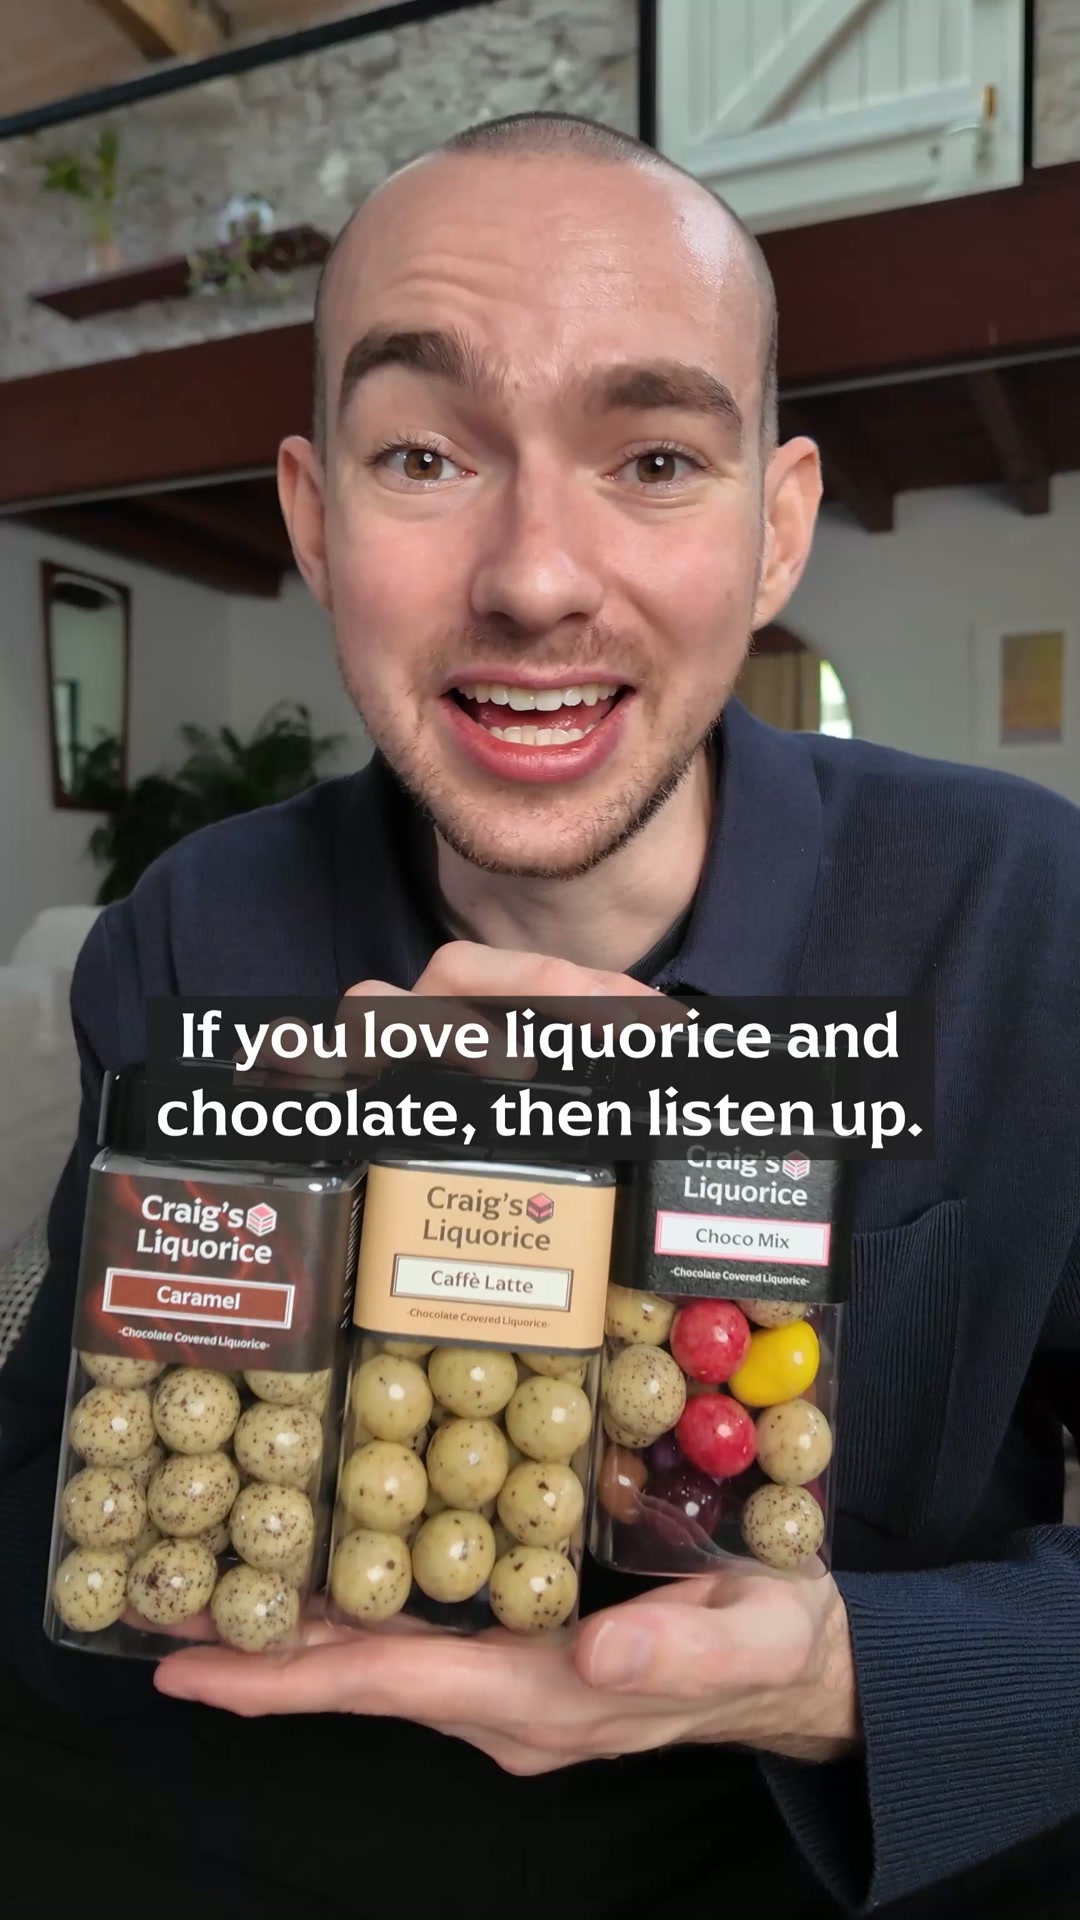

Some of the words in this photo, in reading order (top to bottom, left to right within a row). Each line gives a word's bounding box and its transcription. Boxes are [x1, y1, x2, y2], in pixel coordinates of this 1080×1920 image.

[686, 1144, 779, 1177] Craig's
[427, 1186, 523, 1220] Craig's
[684, 1176, 808, 1206] Liquorice
[141, 1195, 244, 1232] Craig's
[137, 1229, 272, 1264] Liquorice
[423, 1219, 550, 1250] Liquorice
[696, 1229, 753, 1246] Choco
[758, 1233, 789, 1249] Mix
[431, 1270, 480, 1288] Caffè
[485, 1275, 533, 1293] Latte
[723, 1271, 761, 1282] Covered
[157, 1285, 240, 1310] Caramel
[460, 1313, 500, 1325] Covered
[175, 1332, 216, 1346] Covered
